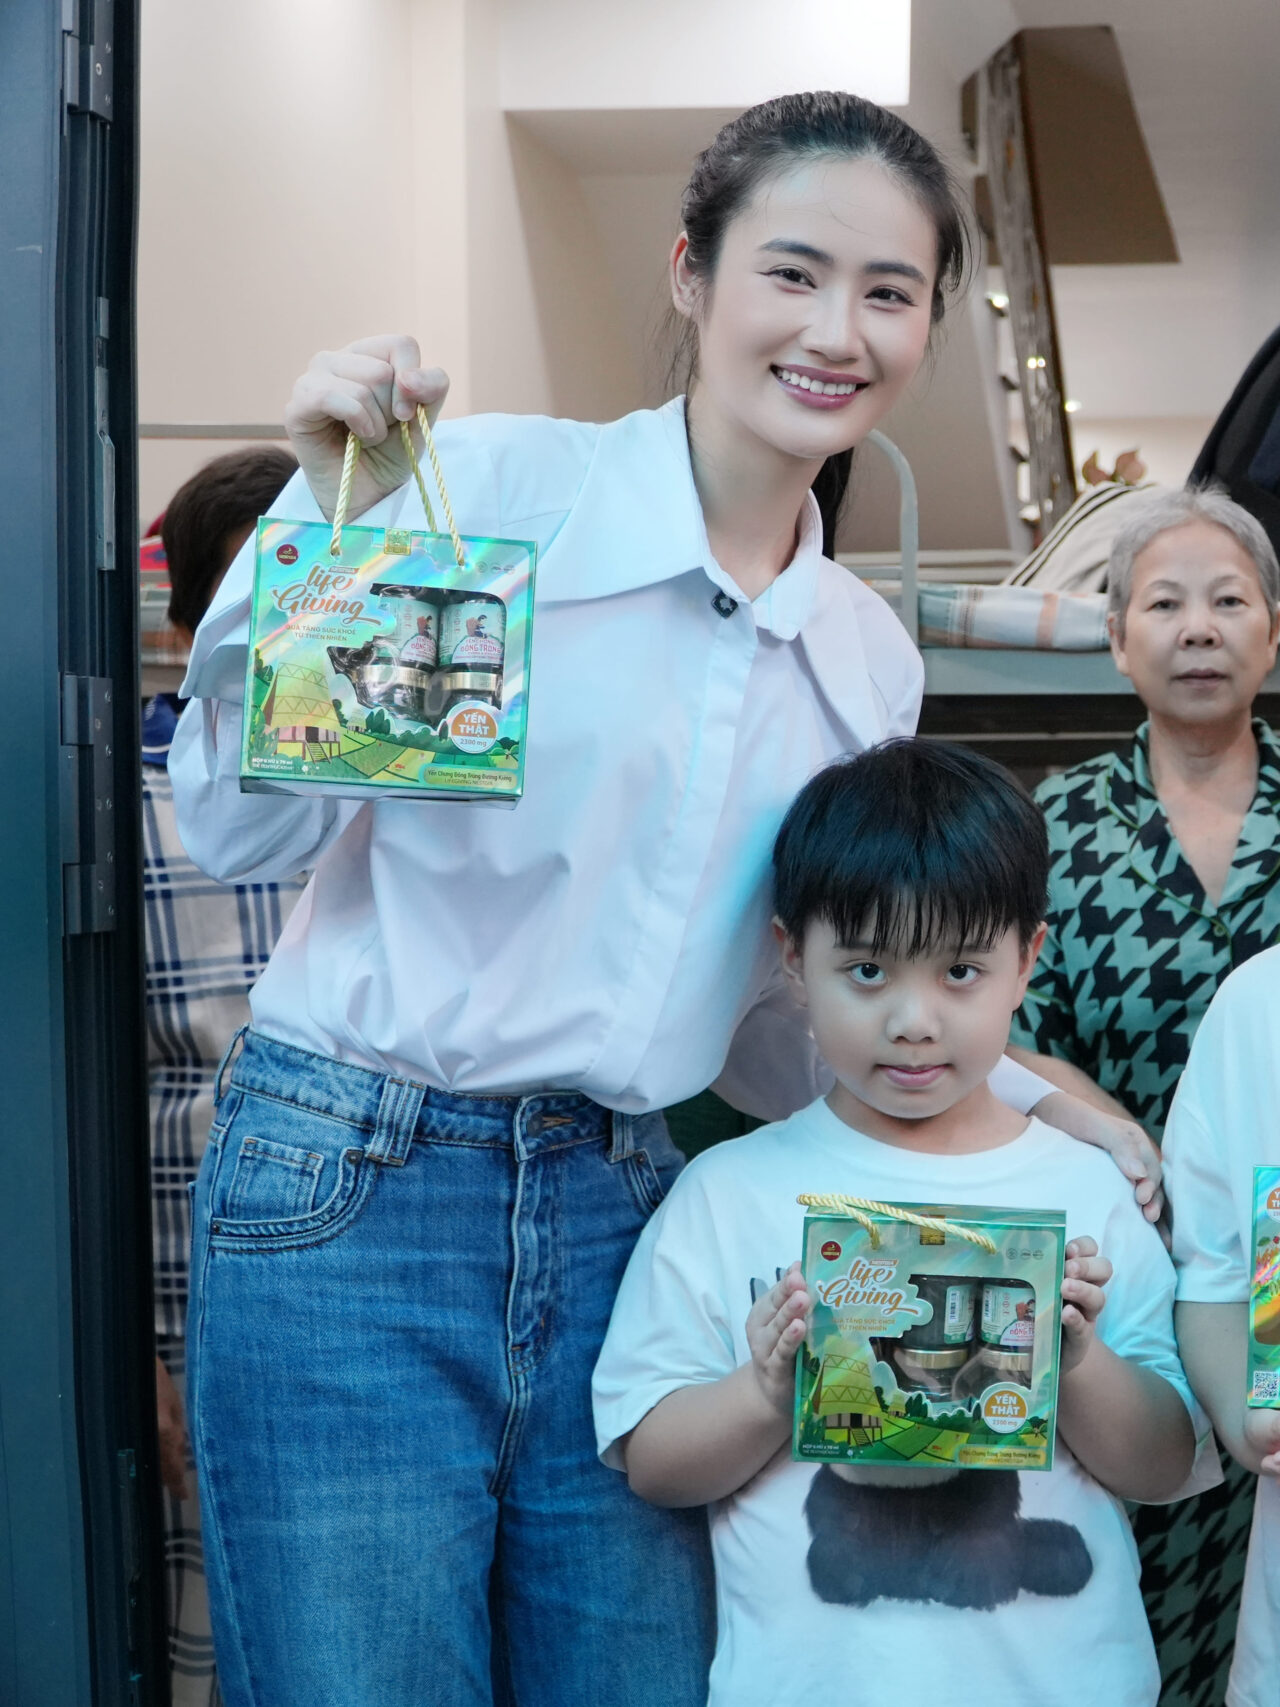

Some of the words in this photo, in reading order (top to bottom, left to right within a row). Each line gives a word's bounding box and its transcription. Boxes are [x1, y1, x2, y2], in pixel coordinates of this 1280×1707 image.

[306, 565, 354, 596] life
[272, 583, 382, 626] Giving
[463, 711, 487, 725] YẾN
[458, 723, 490, 738] THẬT
[476, 740, 488, 748] mg
[849, 1259, 893, 1288] life
[818, 1278, 919, 1315] Giving
[994, 1393, 1017, 1405] YẾN
[990, 1404, 1020, 1418] THẬT
